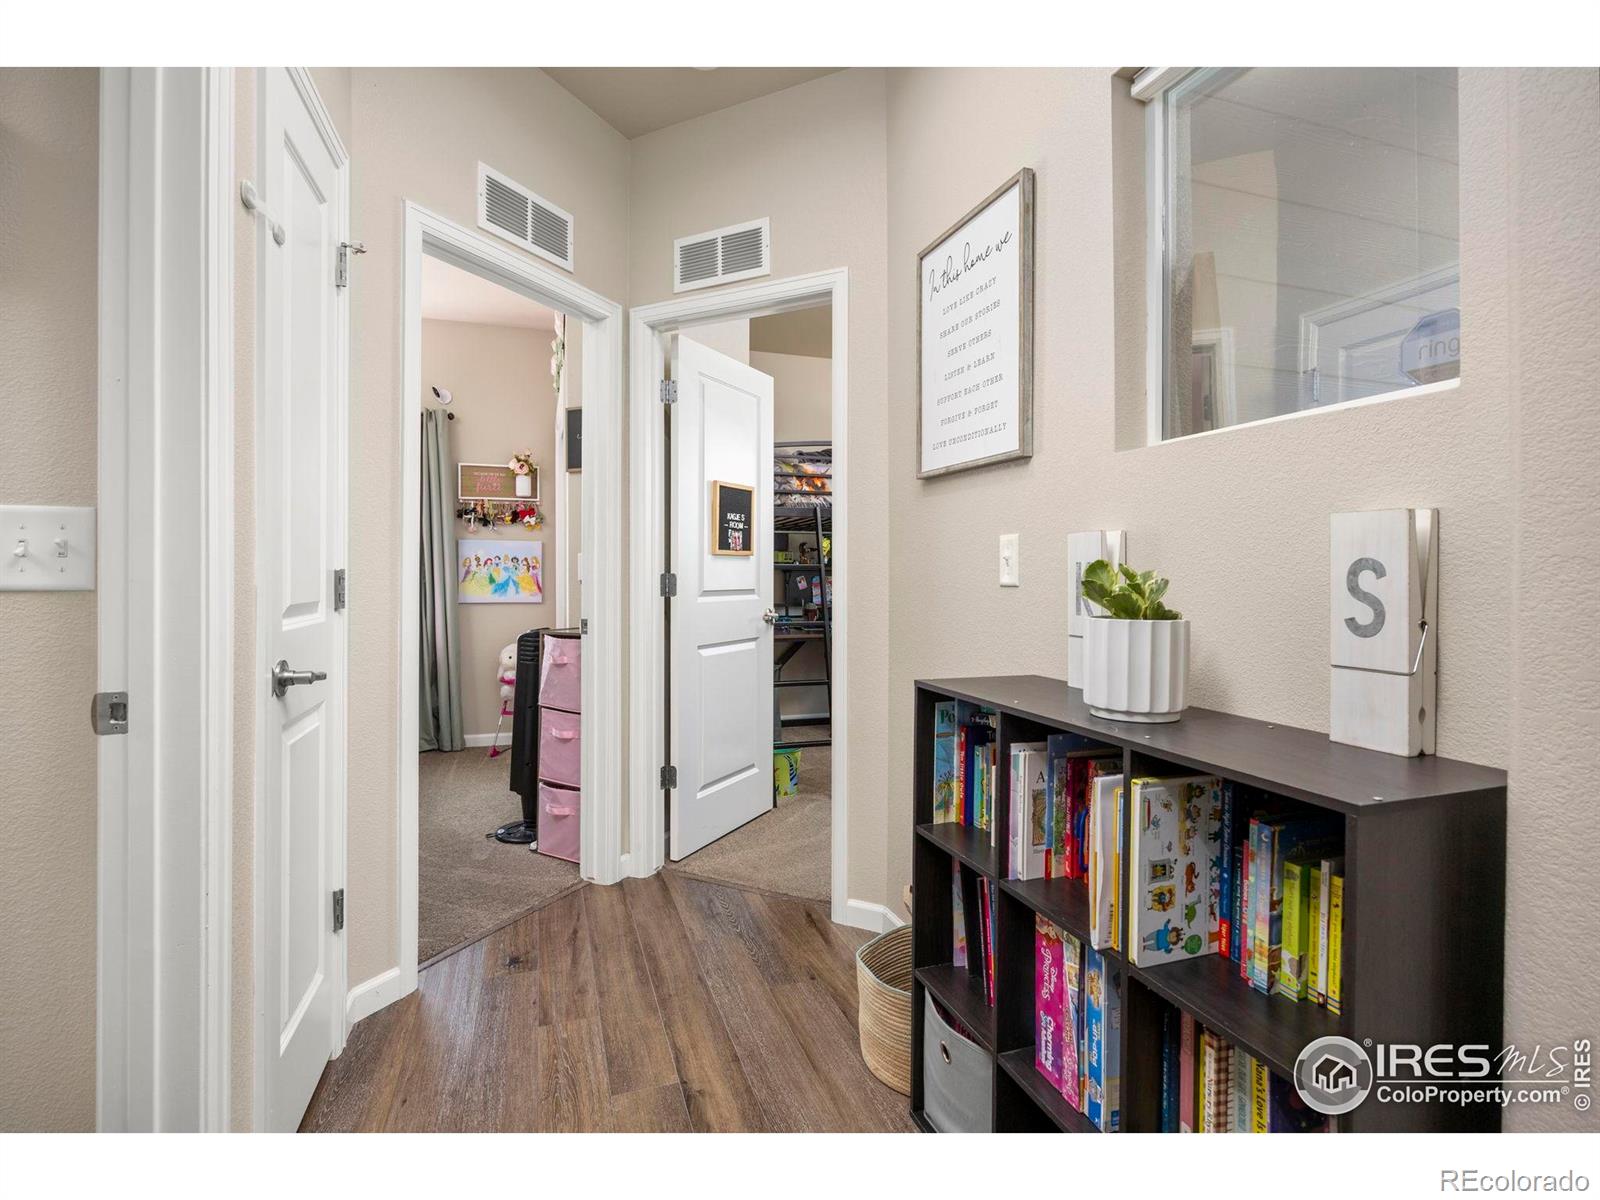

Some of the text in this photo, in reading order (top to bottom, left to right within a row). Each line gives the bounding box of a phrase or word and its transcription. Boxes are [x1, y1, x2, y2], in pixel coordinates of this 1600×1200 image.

[929, 231, 1013, 302] In this home we
[942, 276, 996, 316] LOVE LIKE CRAZY
[940, 299, 1000, 339] SHARE OUR STORIES
[947, 329, 992, 358] SERVE OTHERS
[1418, 337, 1460, 360] ring
[944, 366, 965, 382] LISTEN
[974, 352, 996, 368] LEARN
[936, 373, 1004, 406] SUPPORT EACH OTHER
[940, 411, 966, 427] FORGIVE
[974, 400, 999, 415] FORGET
[932, 422, 1007, 451] LOVE UNCONDITIONALLY
[1343, 556, 1387, 638] S
[1256, 1094, 1266, 1120] Love
[1256, 1121, 1266, 1132] Is
